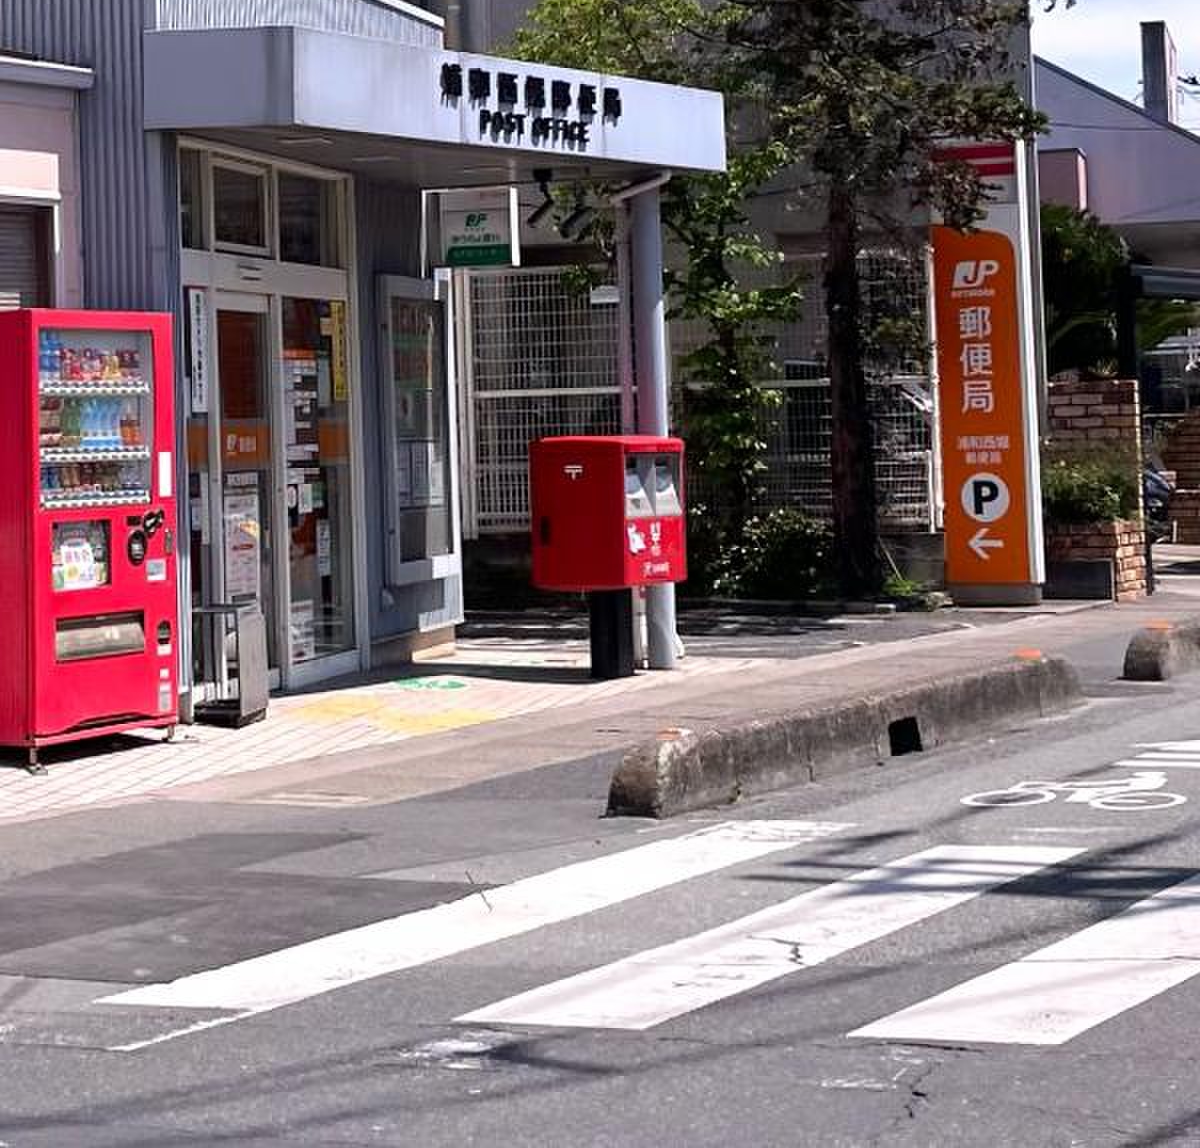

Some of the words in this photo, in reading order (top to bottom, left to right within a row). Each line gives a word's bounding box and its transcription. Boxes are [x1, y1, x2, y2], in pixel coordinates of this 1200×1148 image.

[479, 109, 527, 136] POST
[532, 116, 590, 143] OFFICE
[960, 306, 995, 415] 郵便局
[972, 479, 1000, 515] P
